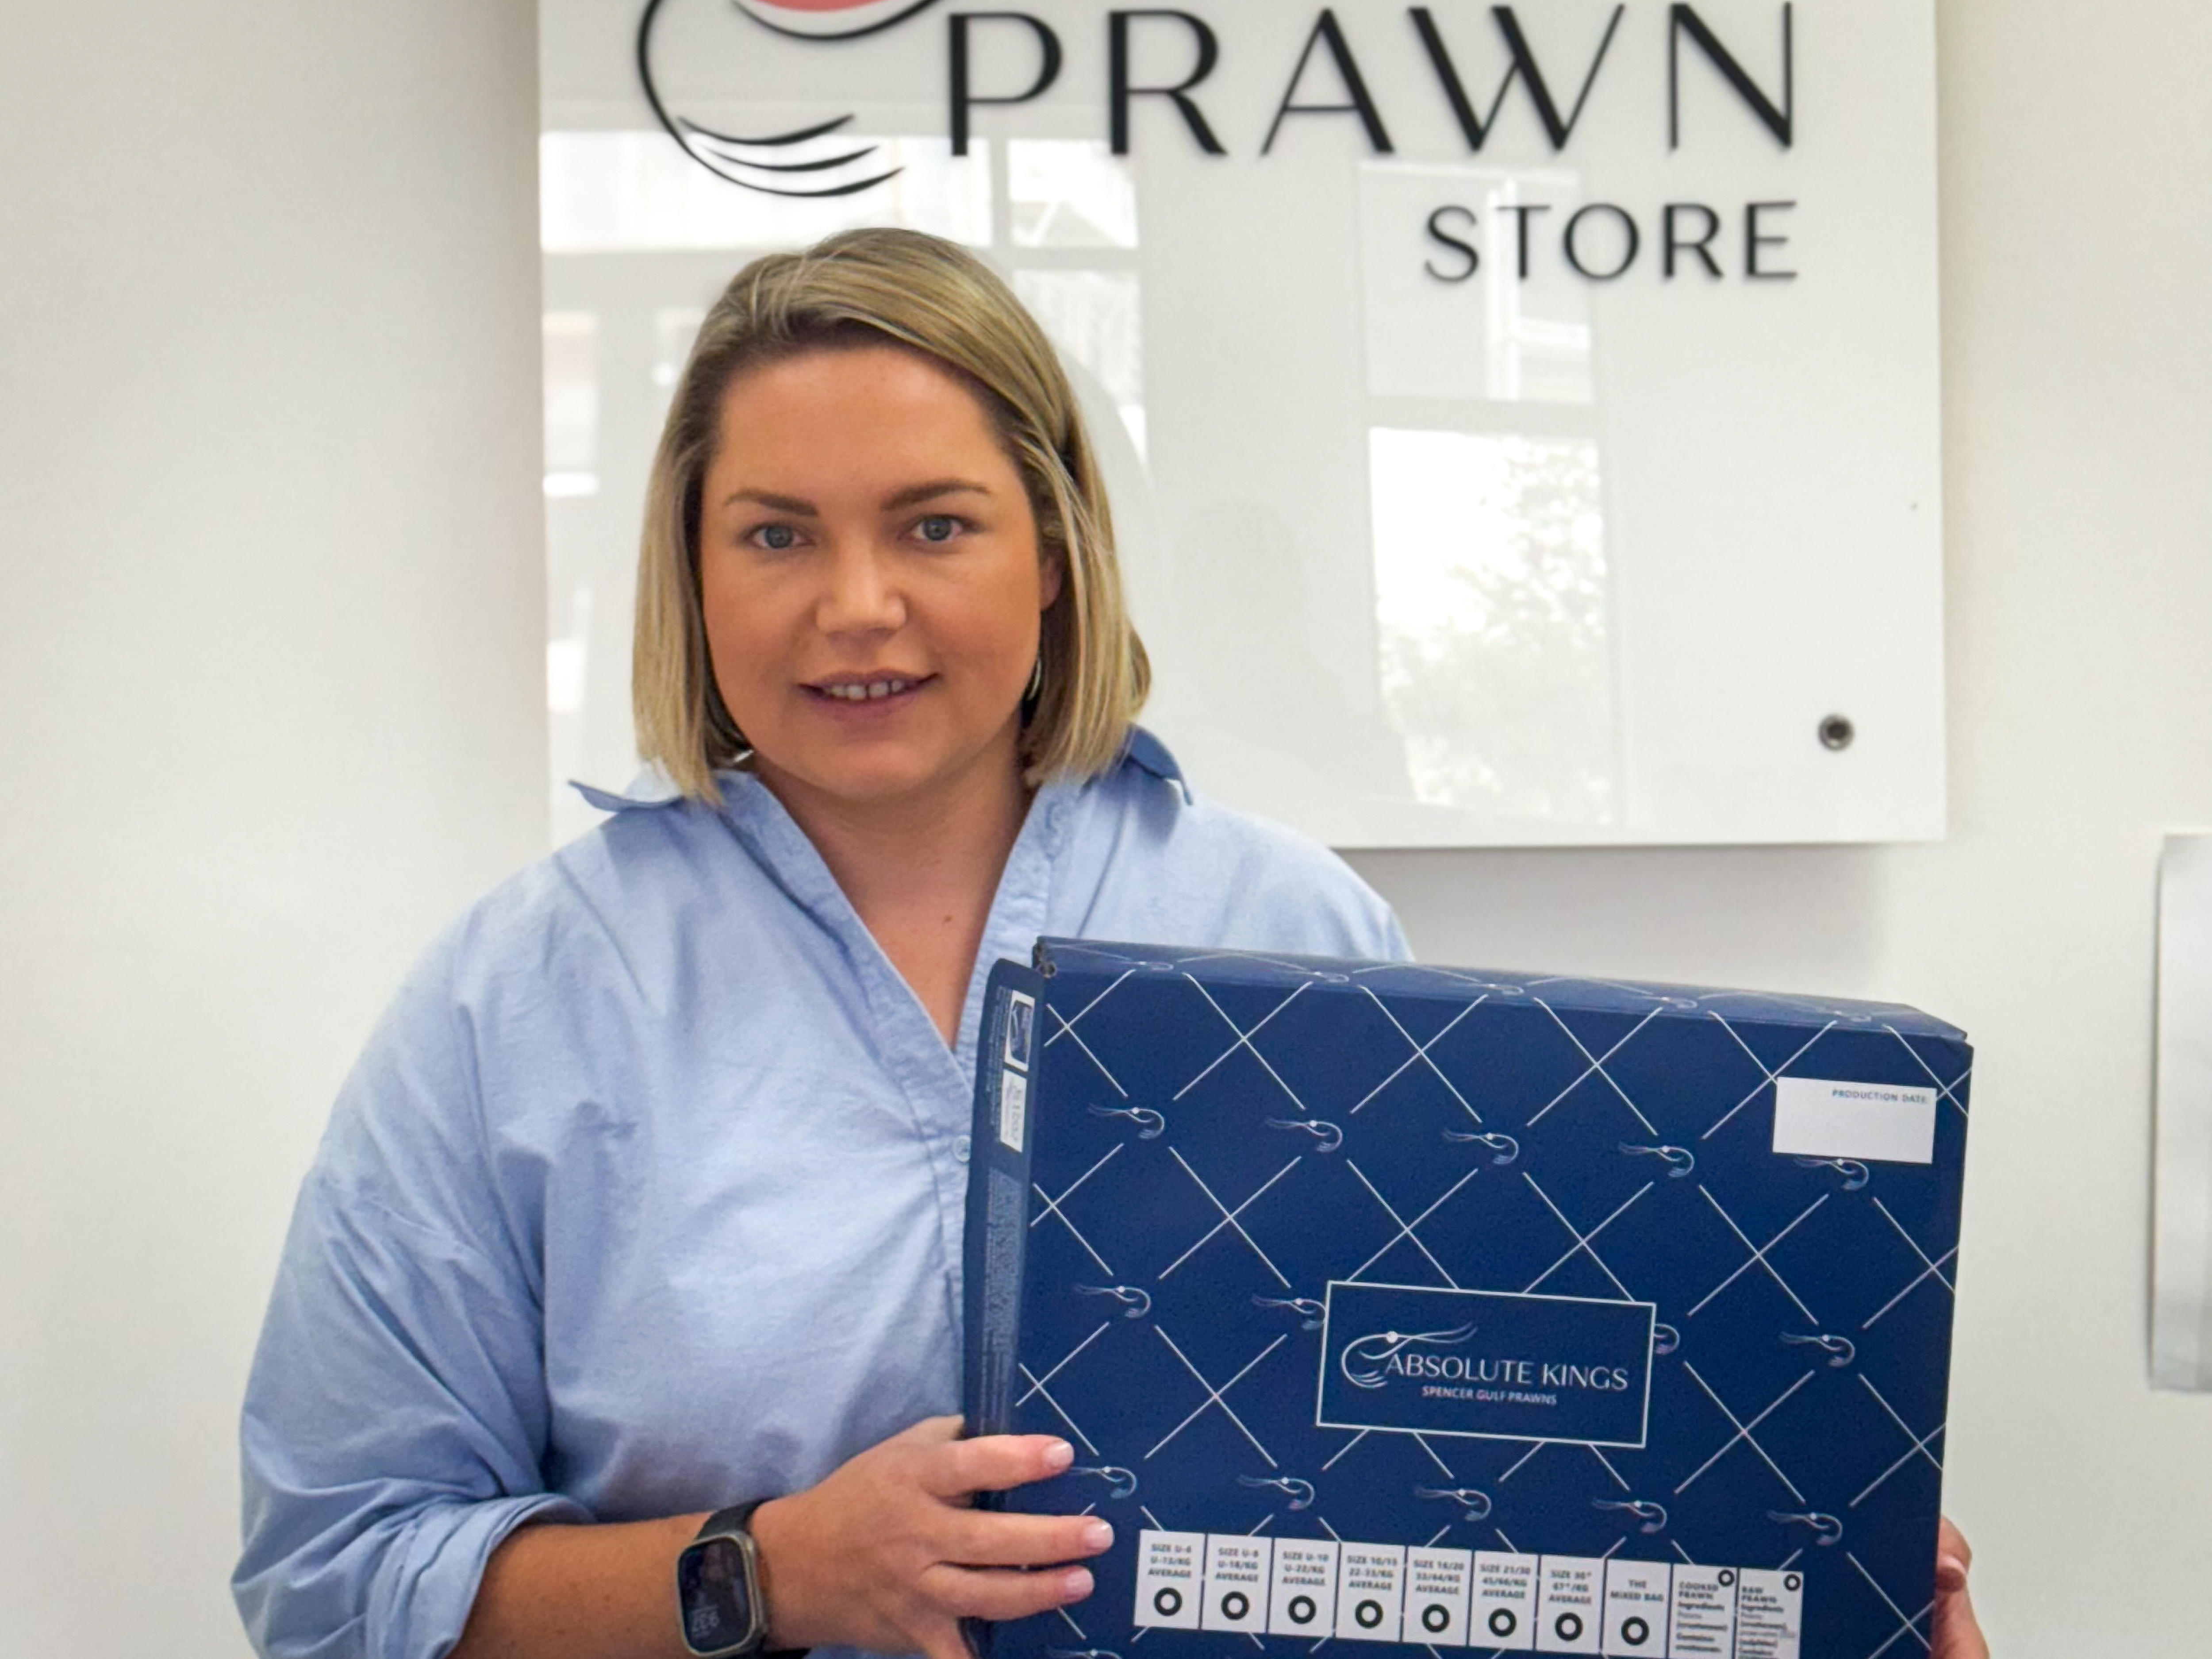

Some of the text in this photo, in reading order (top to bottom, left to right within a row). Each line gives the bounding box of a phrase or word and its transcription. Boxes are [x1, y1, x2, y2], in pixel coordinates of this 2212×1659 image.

[947, 4, 1793, 157] PRAWN
[1424, 200, 1797, 282] STORE
[1832, 1089, 1898, 1102] PRODUCTION
[1385, 1353, 1629, 1391] ABSOLUTE KINGS
[1422, 1385, 1557, 1406] SPENCER GULF PRAWNS
[1152, 1543, 1171, 1552] SIZE
[1219, 1547, 1238, 1556] SIZE
[1283, 1551, 1302, 1560] SIZE
[1348, 1555, 1367, 1564] SIZE
[1413, 1559, 1433, 1568] SIZE
[1480, 1563, 1500, 1572] SIZE
[1148, 1569, 1191, 1578] AVERAGE
[1216, 1572, 1258, 1582] AVERAGE
[1551, 1570, 1570, 1578] SIZE
[1283, 1576, 1325, 1586] AVERAGE
[1349, 1581, 1392, 1590] AVERAGE
[1628, 1579, 1647, 1589] THE
[1416, 1585, 1459, 1594] AVERAGE
[1679, 1582, 1718, 1591] COOKED
[1482, 1589, 1525, 1599] AVERAGE
[1610, 1591, 1663, 1601] MIXED BAG
[1549, 1594, 1591, 1604] AVERAGE
